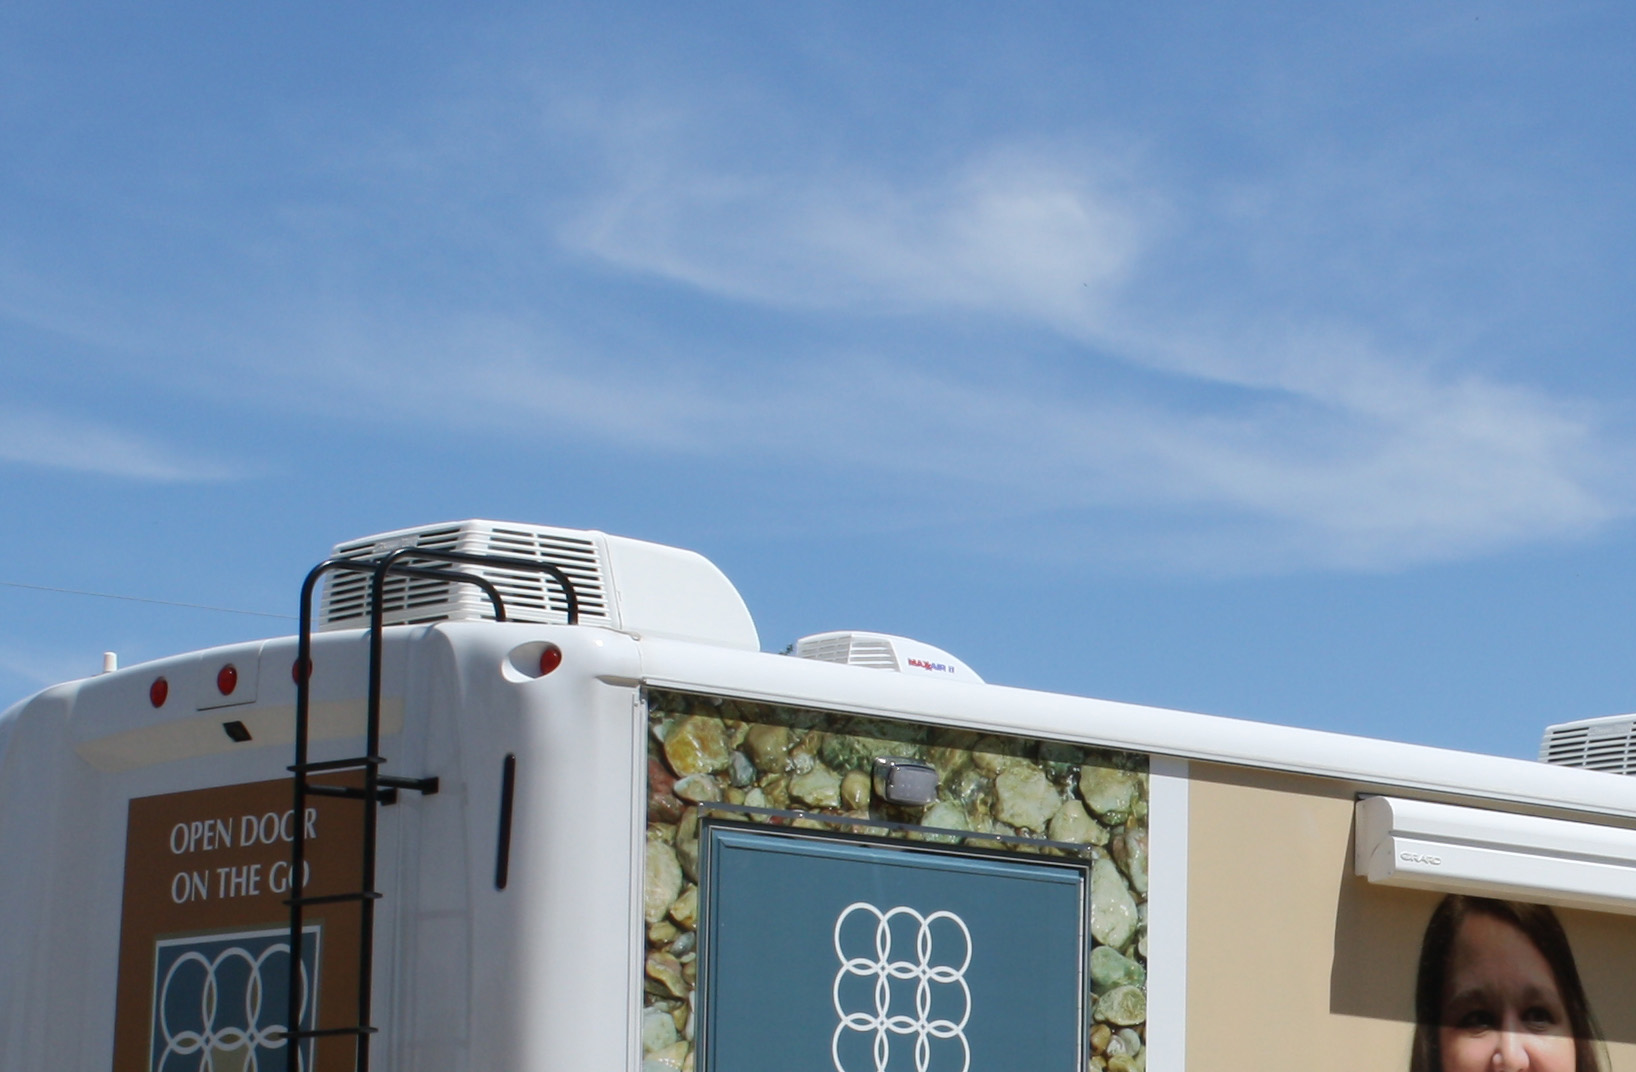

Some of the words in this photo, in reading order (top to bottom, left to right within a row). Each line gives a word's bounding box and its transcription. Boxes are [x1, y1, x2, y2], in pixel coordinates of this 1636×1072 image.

[170, 817, 233, 855] OPEN
[240, 807, 318, 848] DOOR
[171, 870, 209, 904] ON
[217, 864, 262, 899] THE
